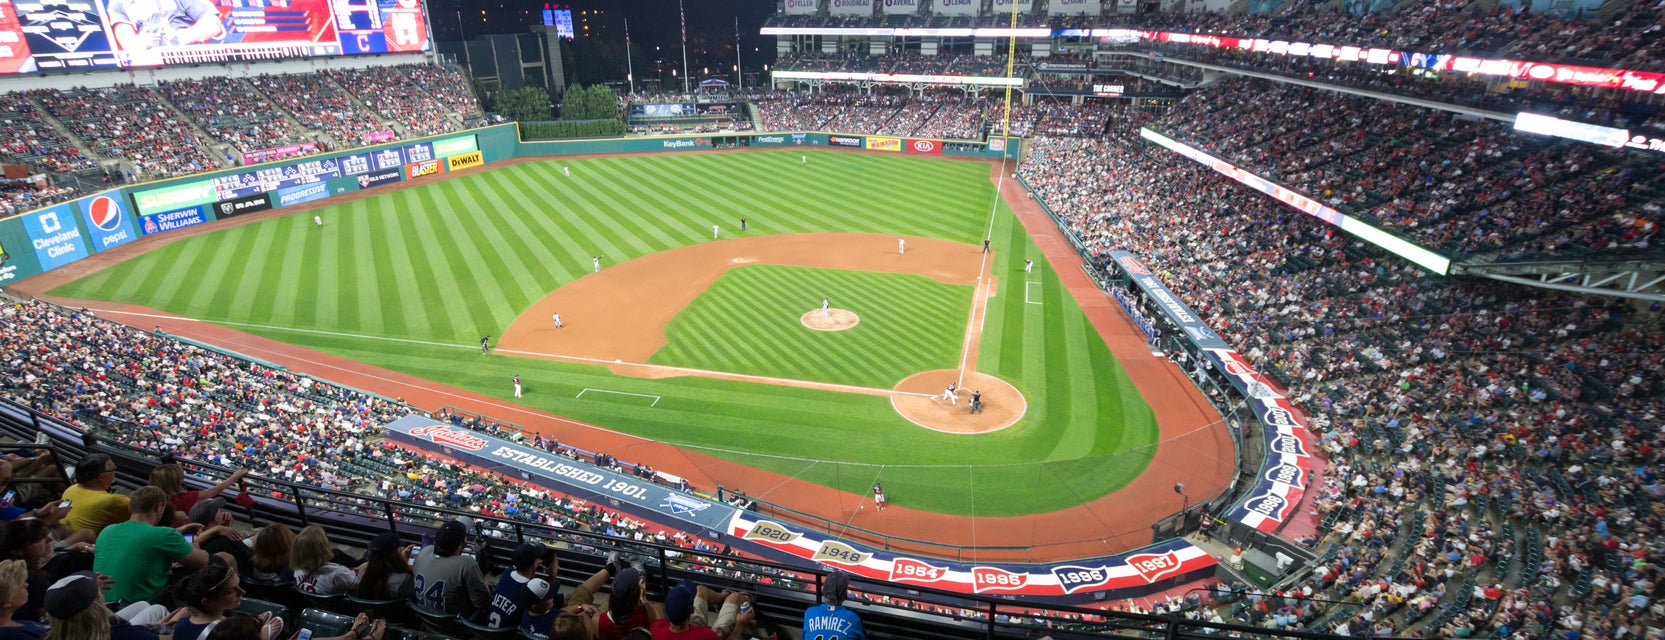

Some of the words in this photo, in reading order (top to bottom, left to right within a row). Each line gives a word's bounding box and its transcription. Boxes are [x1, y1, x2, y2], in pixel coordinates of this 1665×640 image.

[1093, 85, 1103, 93] THE
[1103, 85, 1124, 93] CORNER
[663, 139, 695, 148] KeyBank
[918, 142, 930, 150] KIA
[411, 162, 438, 178] BLASTER
[140, 184, 213, 211] SUBWAY
[280, 183, 327, 204] PROGRESSIVE
[235, 199, 266, 210] RAM
[157, 208, 198, 223] SHERWIN
[33, 227, 80, 250] Cleveland
[103, 230, 128, 247] pepsi
[48, 243, 75, 258] Clinic
[409, 425, 488, 450] Indians
[491, 446, 604, 485] ESTABLISHED
[1276, 464, 1298, 484] 1999
[1254, 495, 1283, 515] 1998
[753, 524, 791, 542] 1920
[821, 545, 861, 563] 1948
[895, 563, 938, 579] 1954
[1134, 555, 1174, 574] 1997
[977, 572, 1021, 586] 1995
[1061, 569, 1104, 585] 1996
[414, 573, 446, 611] 24
[491, 593, 517, 616] JETER
[808, 613, 853, 636] RAMÍREZ
